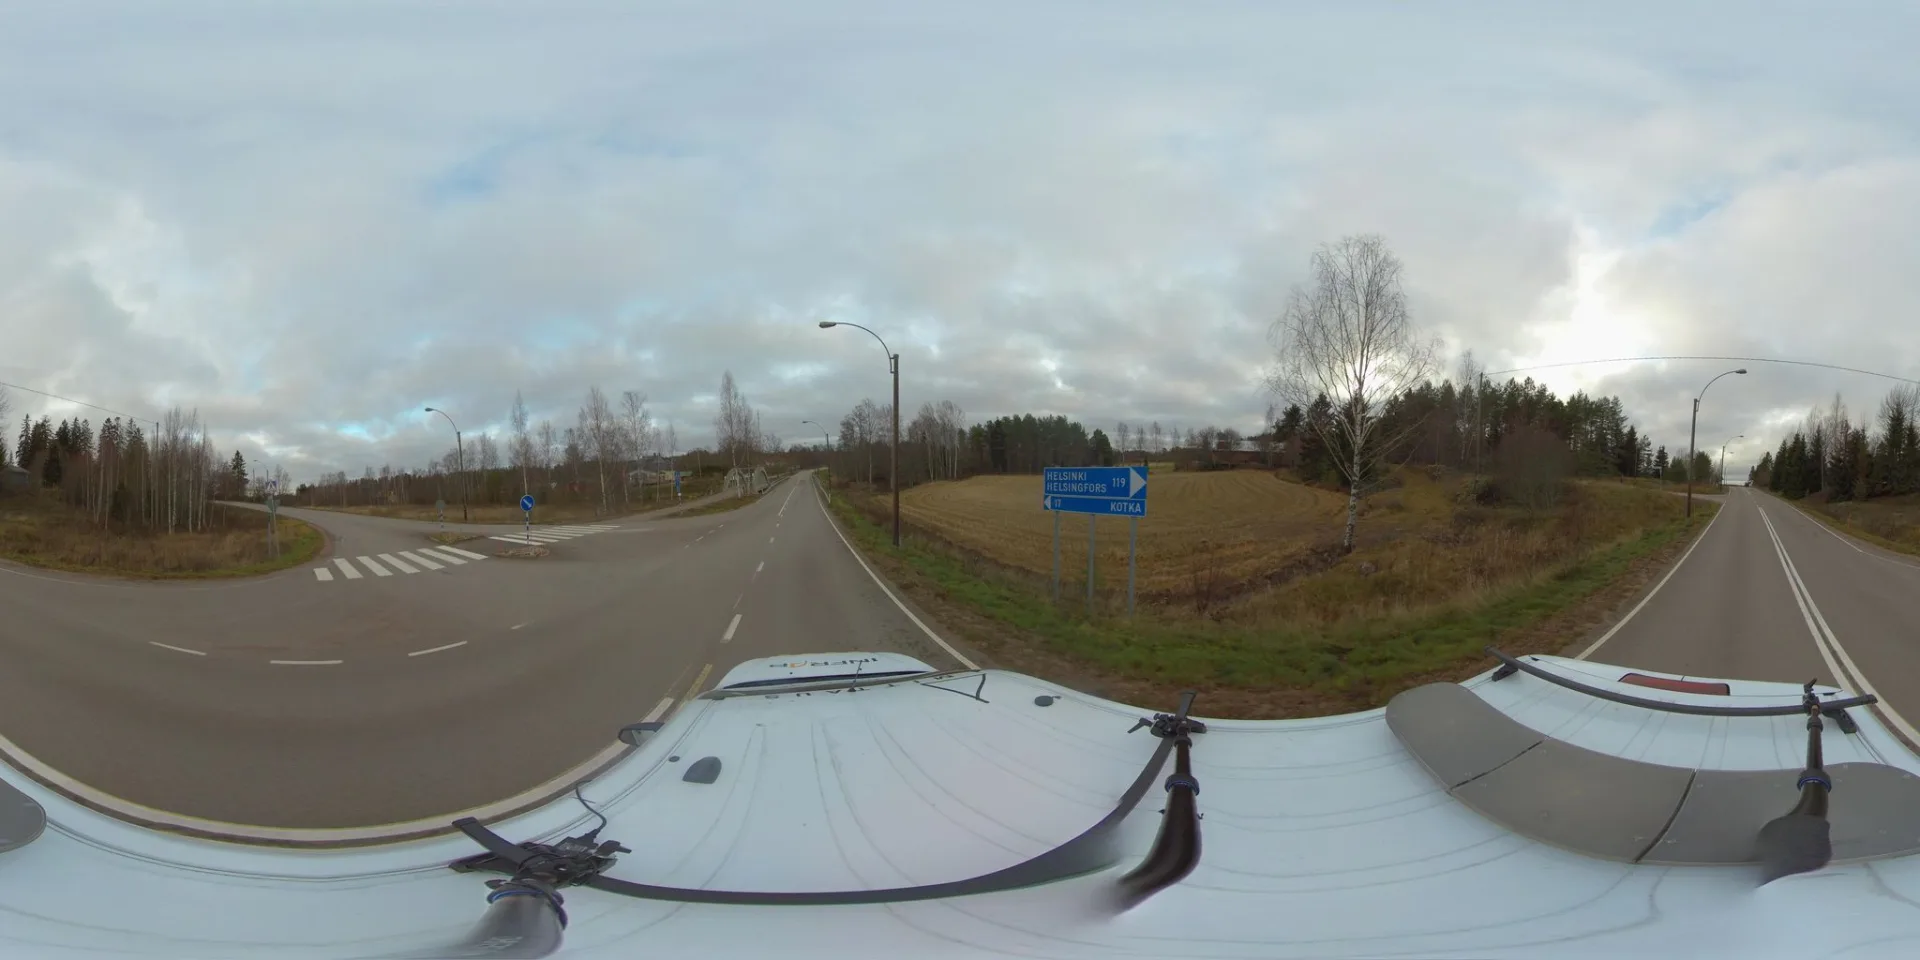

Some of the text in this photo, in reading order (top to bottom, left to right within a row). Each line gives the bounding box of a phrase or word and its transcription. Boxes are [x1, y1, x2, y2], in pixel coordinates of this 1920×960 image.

[1046, 471, 1087, 481] HELSINKI
[1046, 482, 1107, 493] HELSINGFORS
[1112, 477, 1126, 488] 119
[1110, 501, 1142, 513] KOTKA
